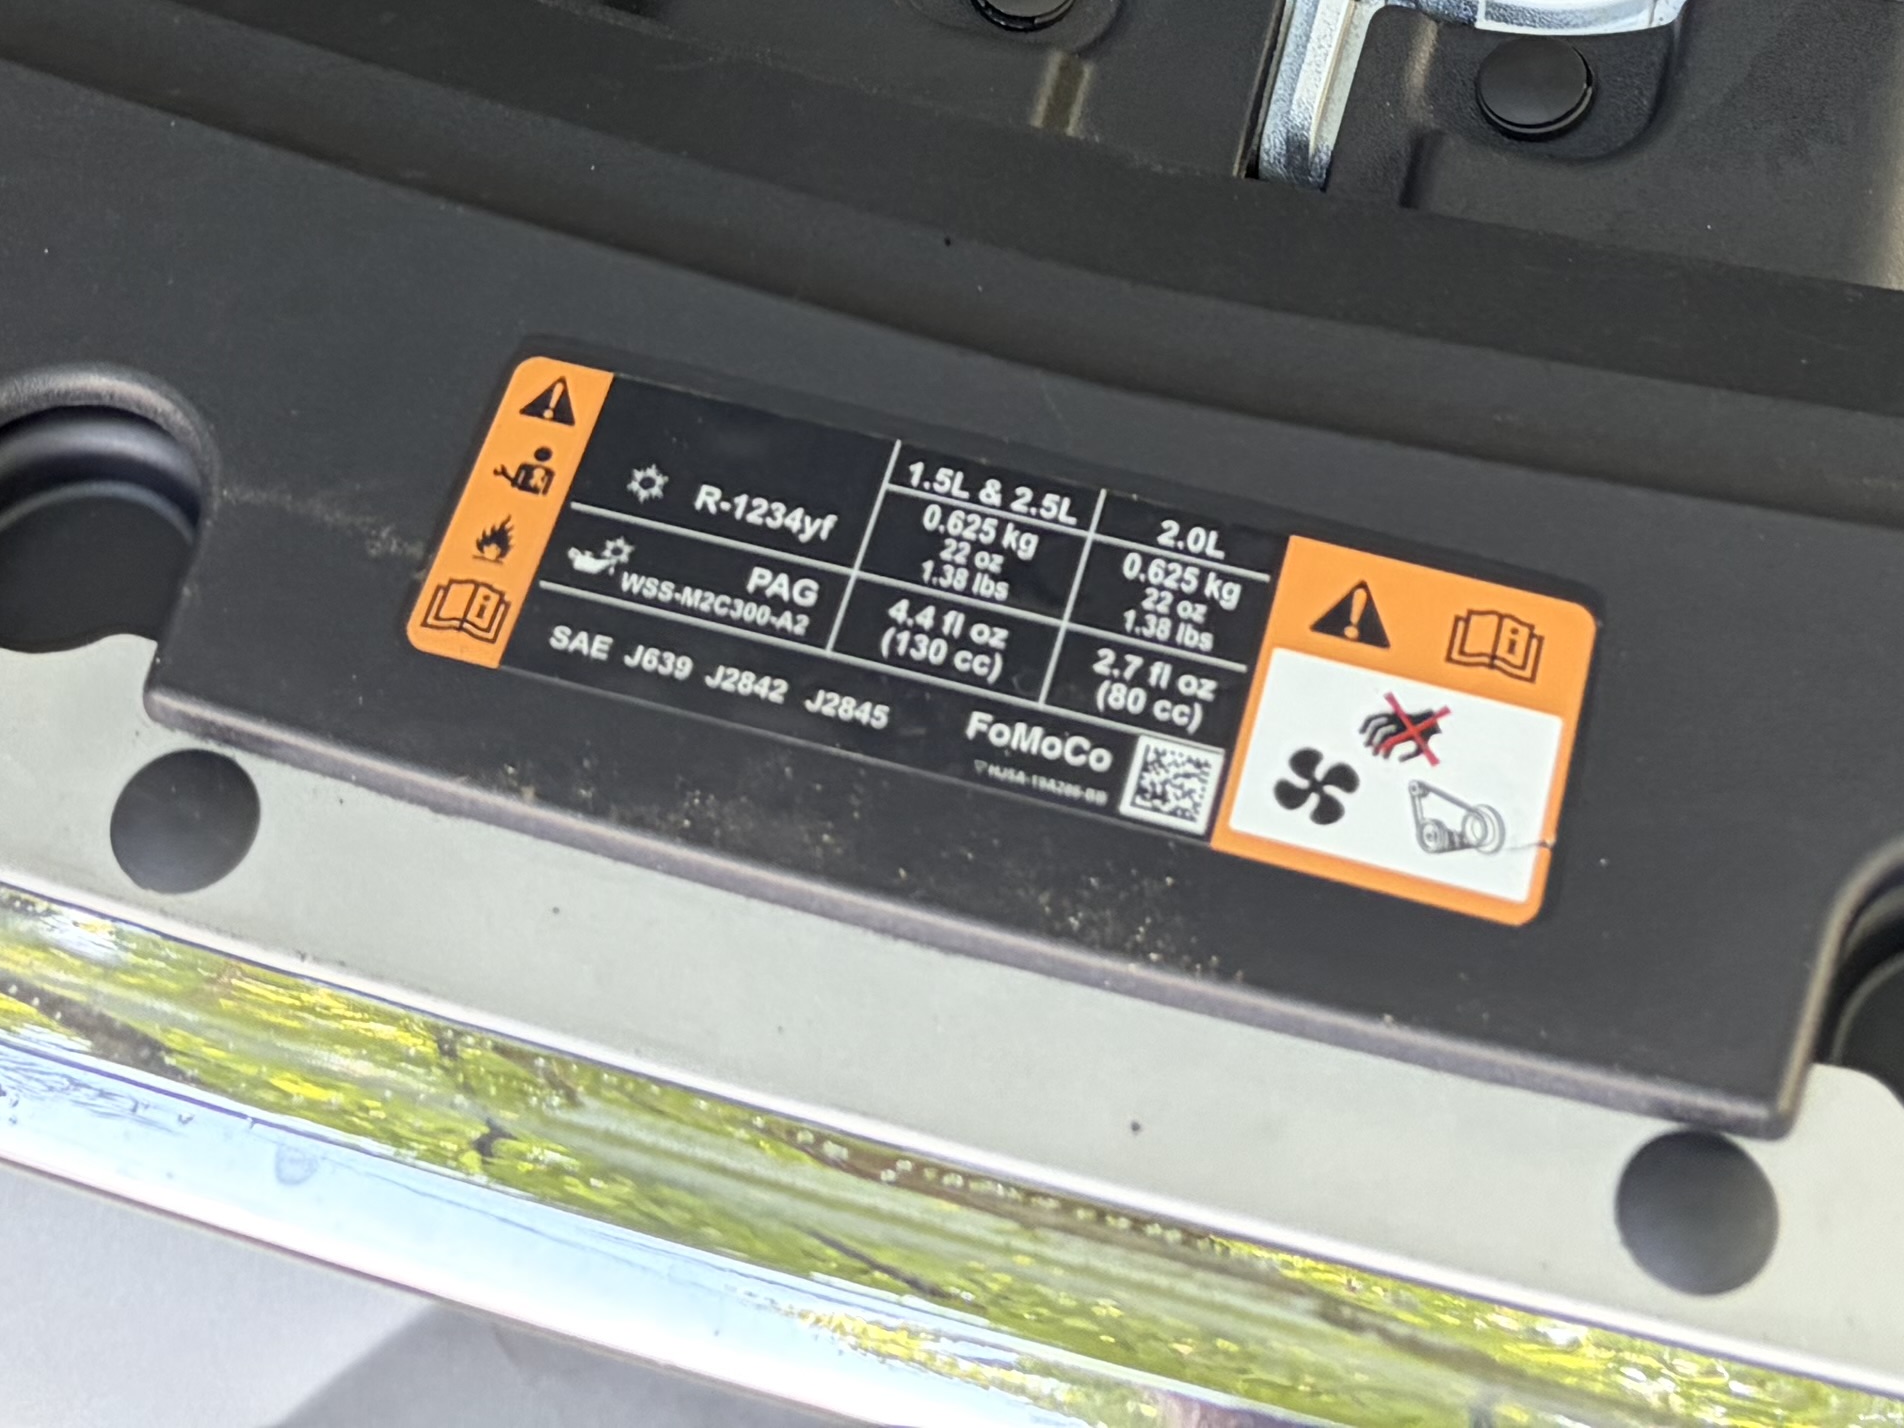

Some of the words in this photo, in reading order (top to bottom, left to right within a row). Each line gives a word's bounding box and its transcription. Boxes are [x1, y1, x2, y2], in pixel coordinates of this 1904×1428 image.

[694, 484, 838, 542] R-1234yf
[908, 461, 970, 500] 1.5L
[979, 479, 1002, 506] &
[1010, 486, 1077, 526] 2.5L
[922, 504, 998, 544] 0.625
[1002, 522, 1039, 561] kg
[939, 538, 971, 564] 22
[974, 551, 1005, 574] oz
[1156, 519, 1225, 560] 2.0L
[620, 571, 810, 636] WSS-M2C300-A2
[747, 566, 820, 607] PAG
[921, 560, 969, 591] 1.38
[971, 572, 1010, 602] lbs
[1122, 552, 1198, 593] 0.625
[1204, 572, 1241, 611] kg
[1140, 588, 1173, 613] 22
[1176, 601, 1207, 624] oz
[888, 598, 936, 631] 4.4
[941, 610, 965, 638] fl
[970, 622, 1009, 650] oz
[1123, 609, 1170, 641] 1.38
[1176, 622, 1214, 652] lbs
[549, 625, 613, 661] SAE
[623, 645, 693, 681] J639
[705, 665, 789, 705] J2842
[804, 689, 890, 730] J2845
[881, 627, 948, 666] (130
[953, 649, 1003, 684] cc)
[1092, 647, 1143, 682] 2.7
[1148, 661, 1172, 689] fl
[1177, 673, 1217, 702] oz
[1096, 679, 1148, 715] (80
[1153, 699, 1203, 734] cc)
[965, 710, 1113, 773] FoMoCo
